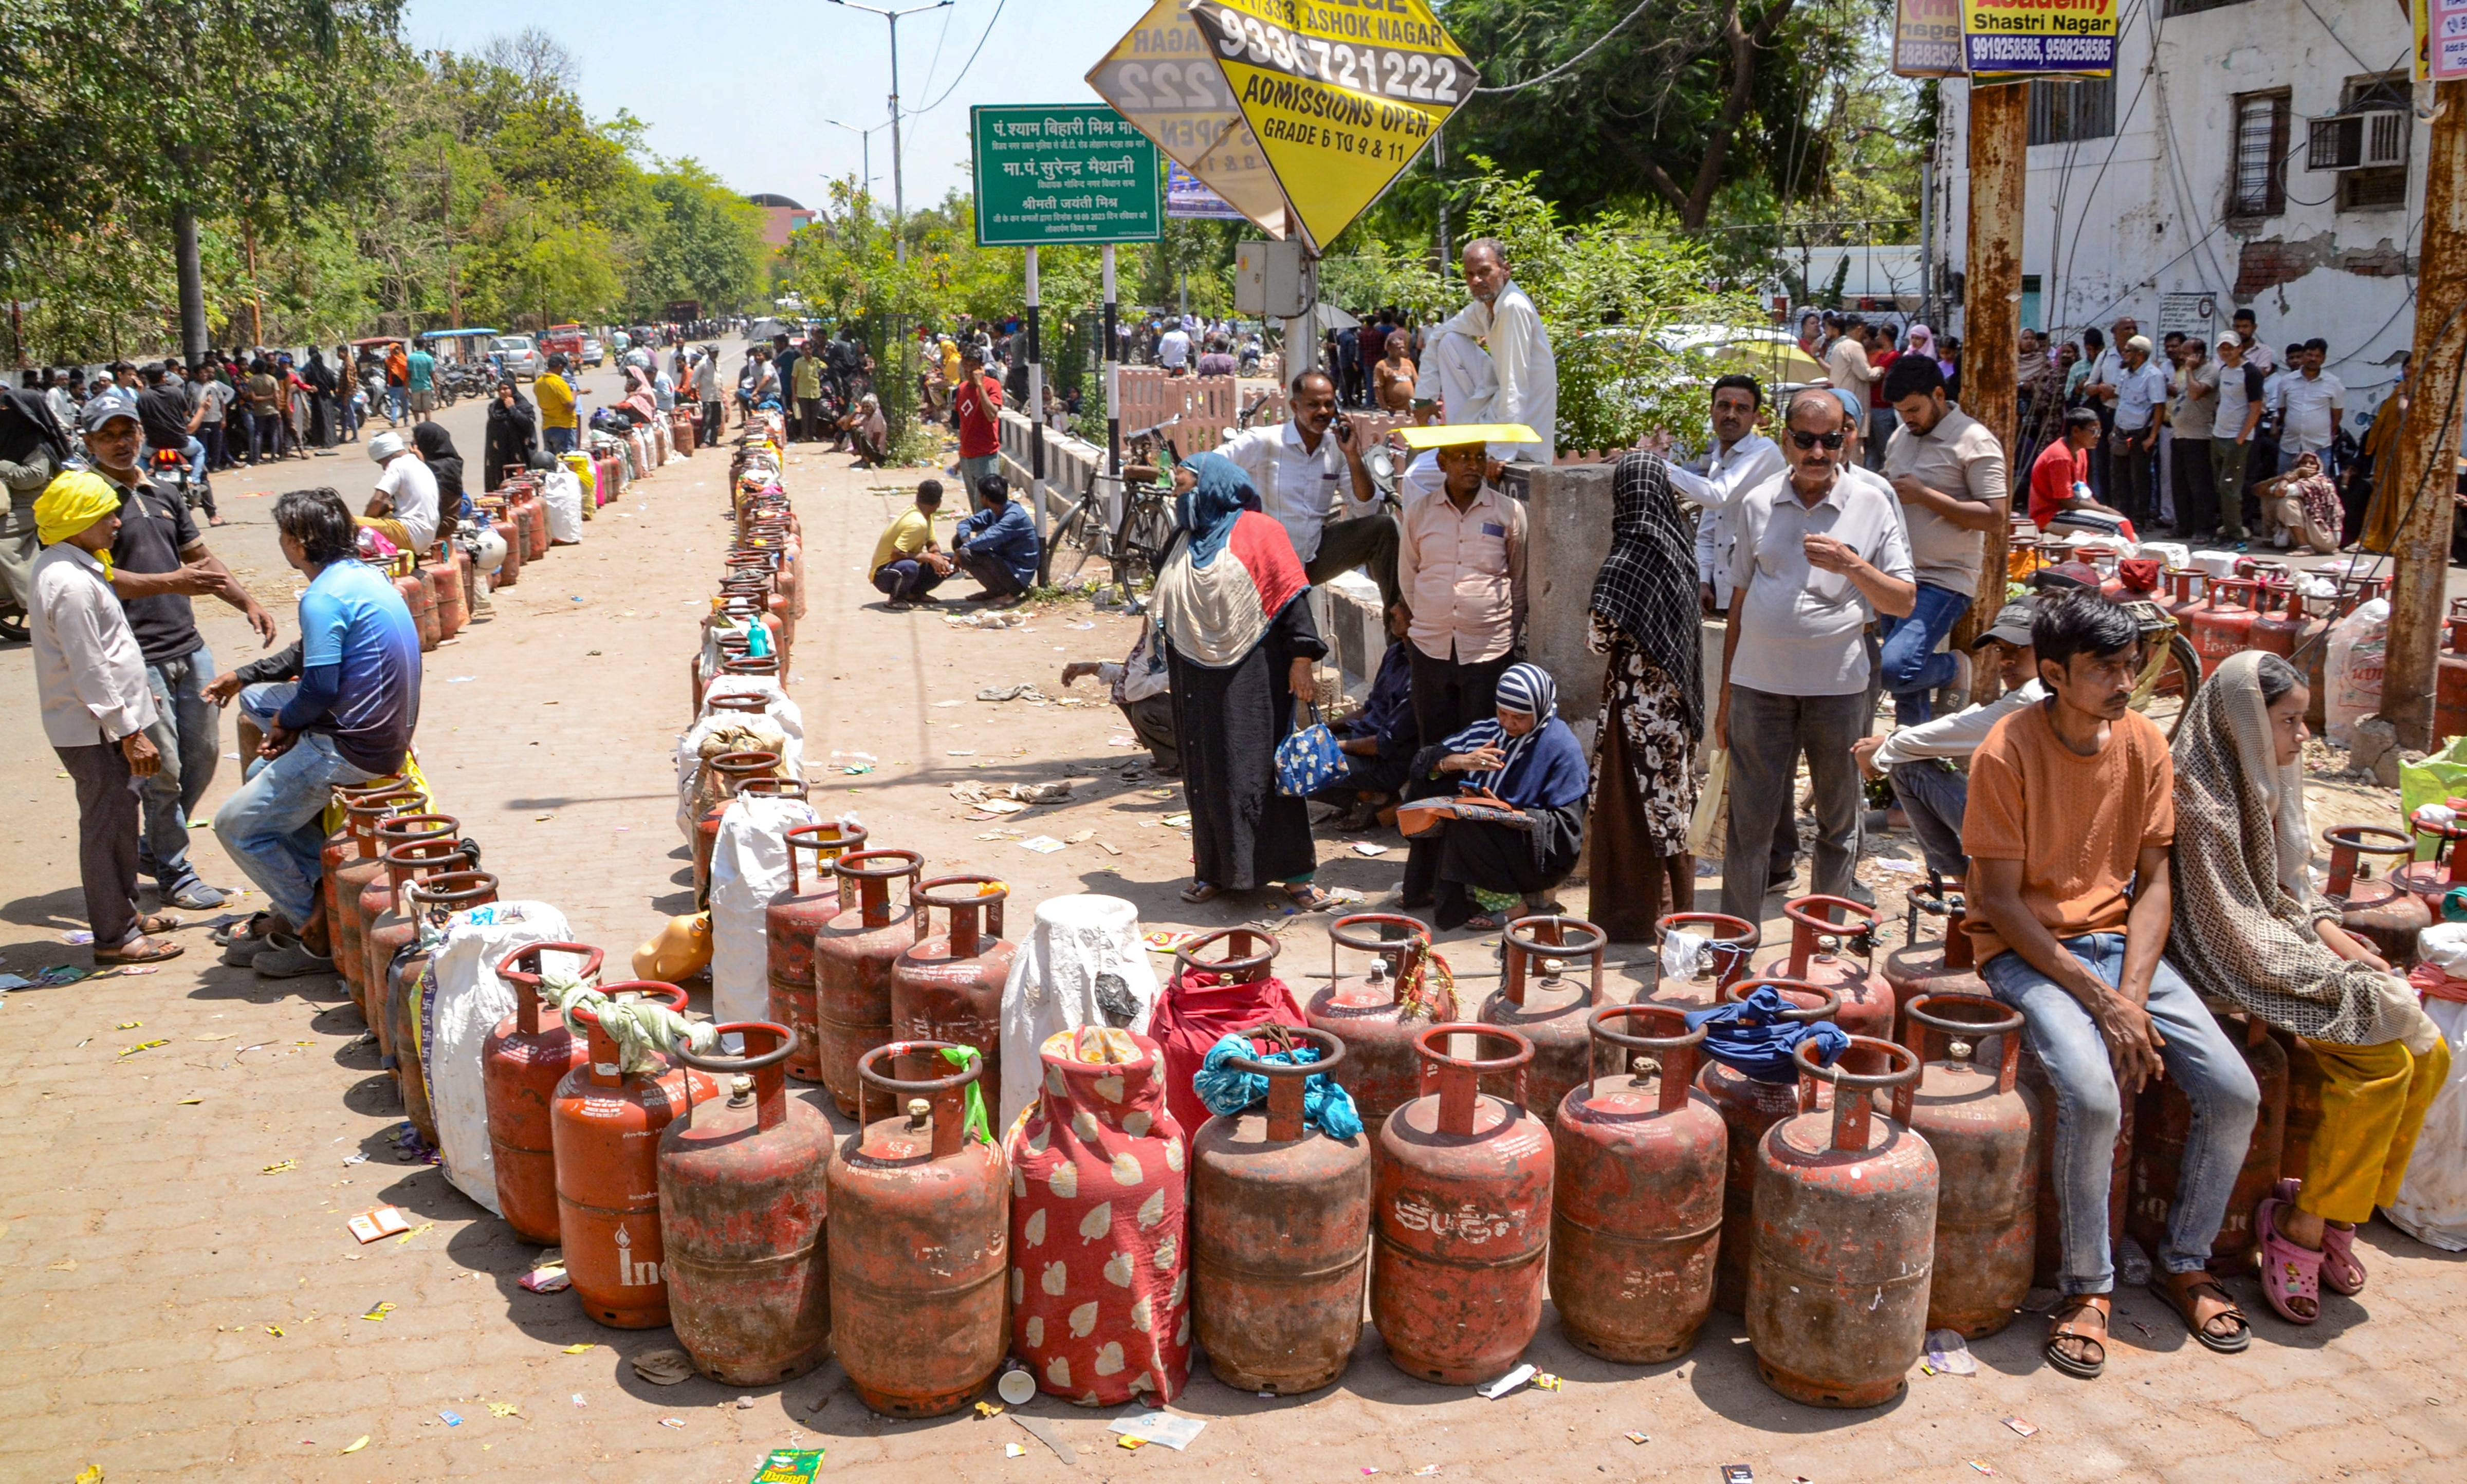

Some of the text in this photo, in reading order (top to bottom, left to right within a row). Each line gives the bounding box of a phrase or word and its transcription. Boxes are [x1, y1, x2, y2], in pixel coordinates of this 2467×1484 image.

[1308, 7, 1371, 39] ASHOK
[1378, 17, 1443, 47] NAGAR
[1974, 13, 2111, 33] Shastri Nagar
[1219, 9, 1458, 102] 9336721222
[1973, 37, 2111, 65] 9919258585, 9598258585
[1242, 73, 1429, 137] ADMISSIONS OPEN
[1044, 117, 1084, 137] बिहारी
[1087, 117, 1114, 135] मिश्र
[1264, 118, 1316, 145] GRADE
[1321, 128, 1330, 147] 6
[1335, 131, 1353, 152] TO
[1358, 137, 1368, 154] 9
[1372, 140, 1383, 158] &
[1389, 142, 1404, 162] 11
[1087, 155, 1134, 174] मैथानी
[1022, 195, 1118, 210] श्रीमती जयंती मिश्र
[1608, 1094, 1640, 1106] 15.7
